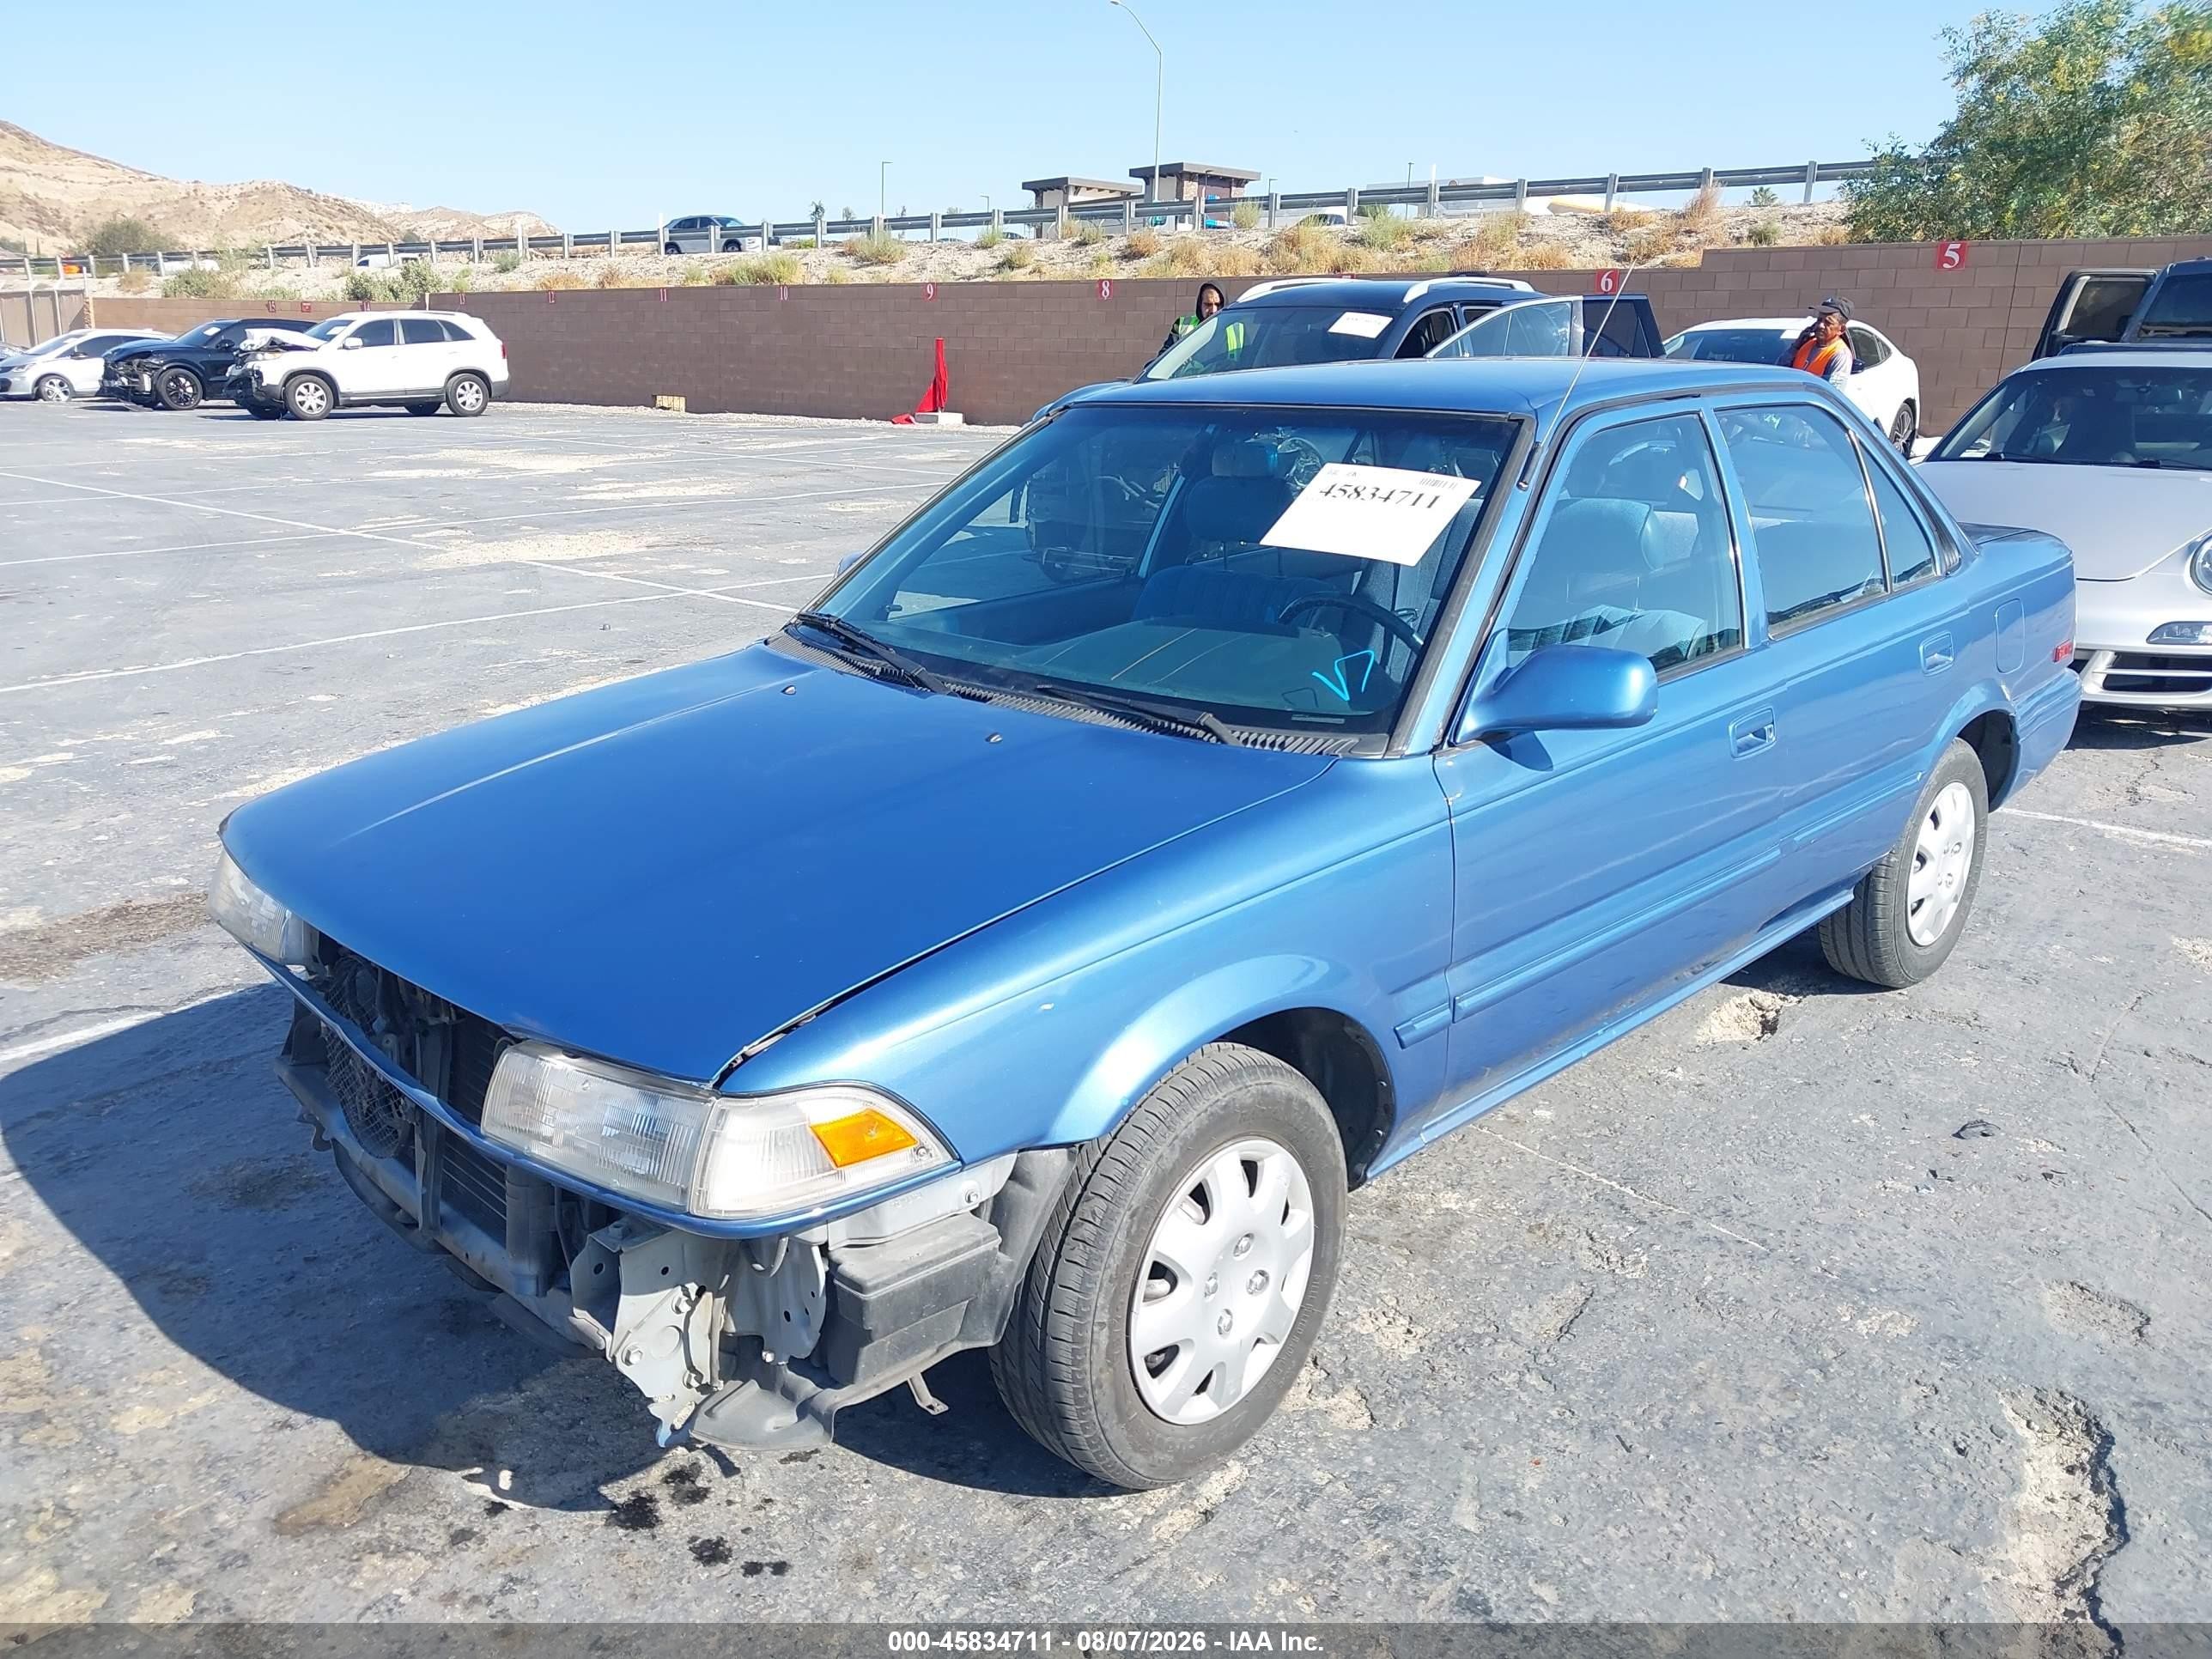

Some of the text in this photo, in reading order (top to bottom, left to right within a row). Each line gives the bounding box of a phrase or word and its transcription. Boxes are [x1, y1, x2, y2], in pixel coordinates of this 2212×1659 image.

[1942, 243, 1961, 269] 5
[1101, 280, 1110, 299] 8
[1601, 270, 1613, 292] 6
[659, 288, 667, 301] 11
[780, 285, 788, 301] 10
[927, 283, 934, 300] 9
[1319, 483, 1440, 508] 45834711
